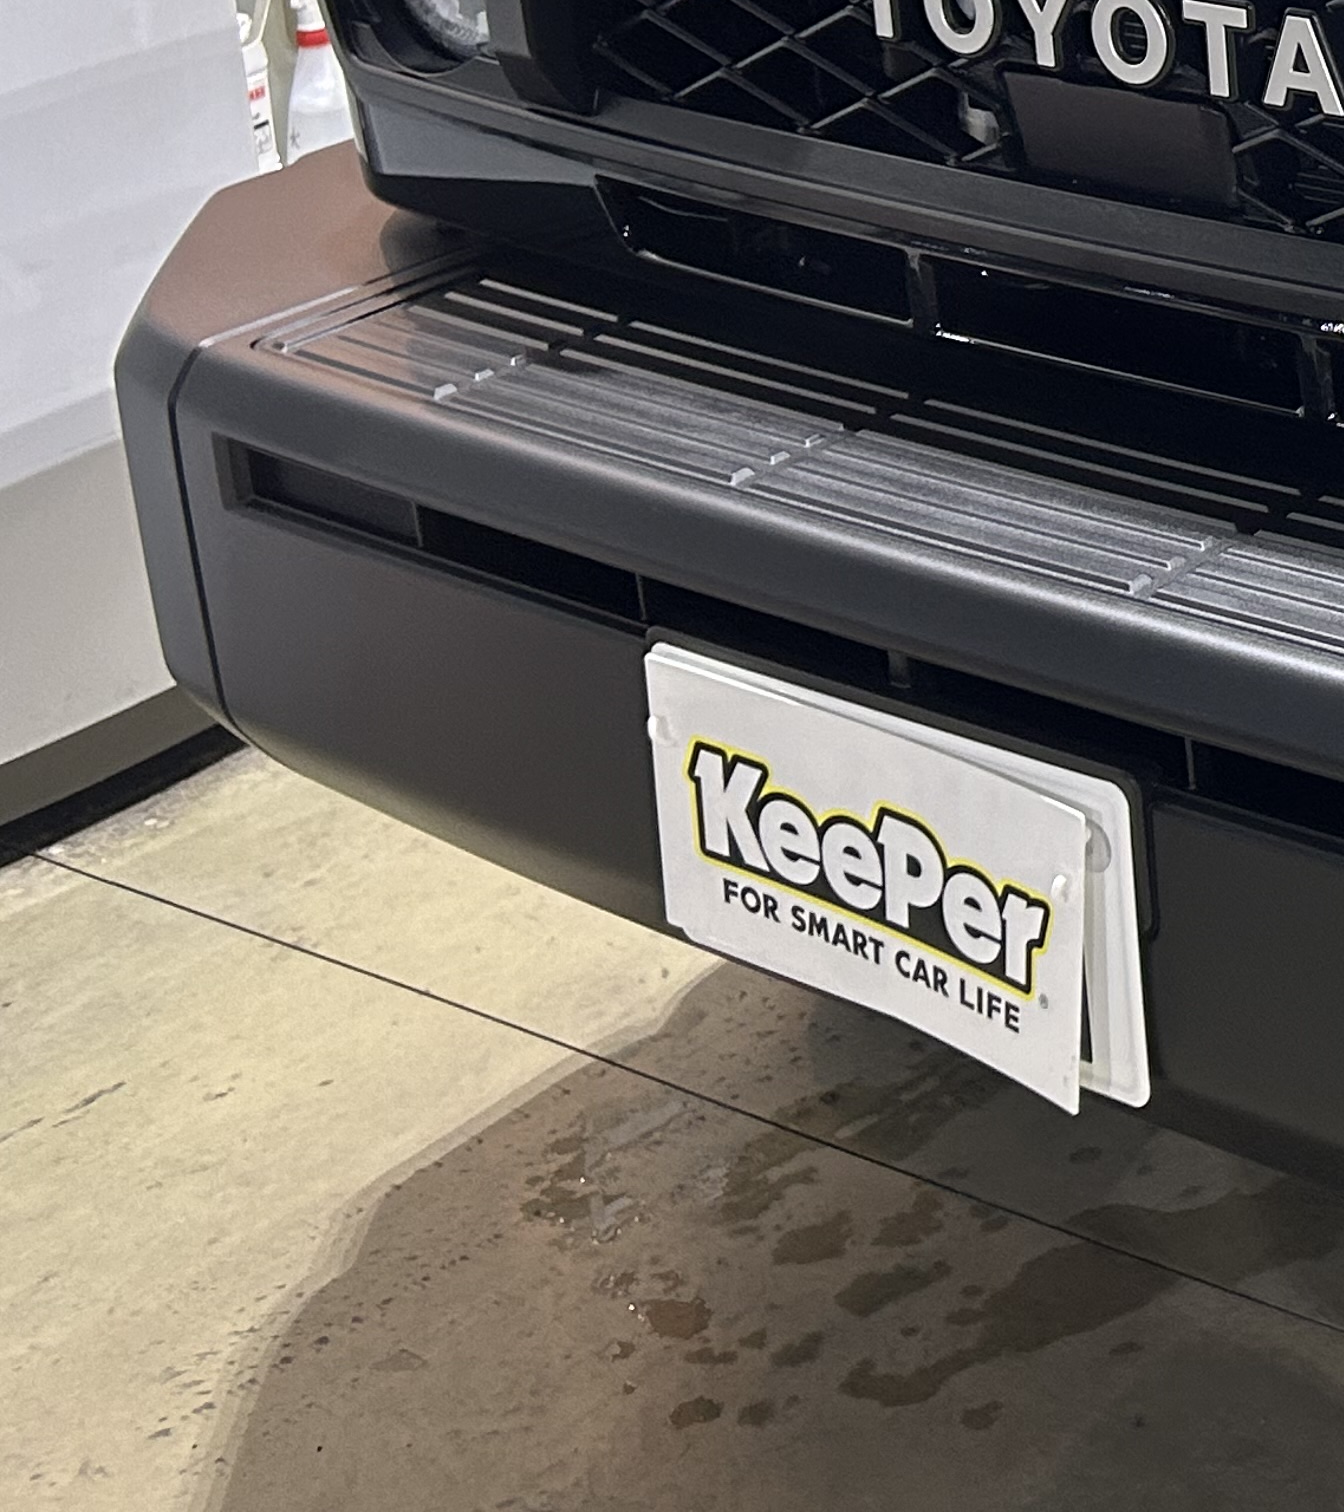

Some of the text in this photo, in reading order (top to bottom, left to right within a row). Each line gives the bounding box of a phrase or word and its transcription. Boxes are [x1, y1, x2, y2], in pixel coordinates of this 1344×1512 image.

[690, 742, 1049, 995] KeePer
[722, 877, 1021, 1033] FOR SMART CAR LIFE
